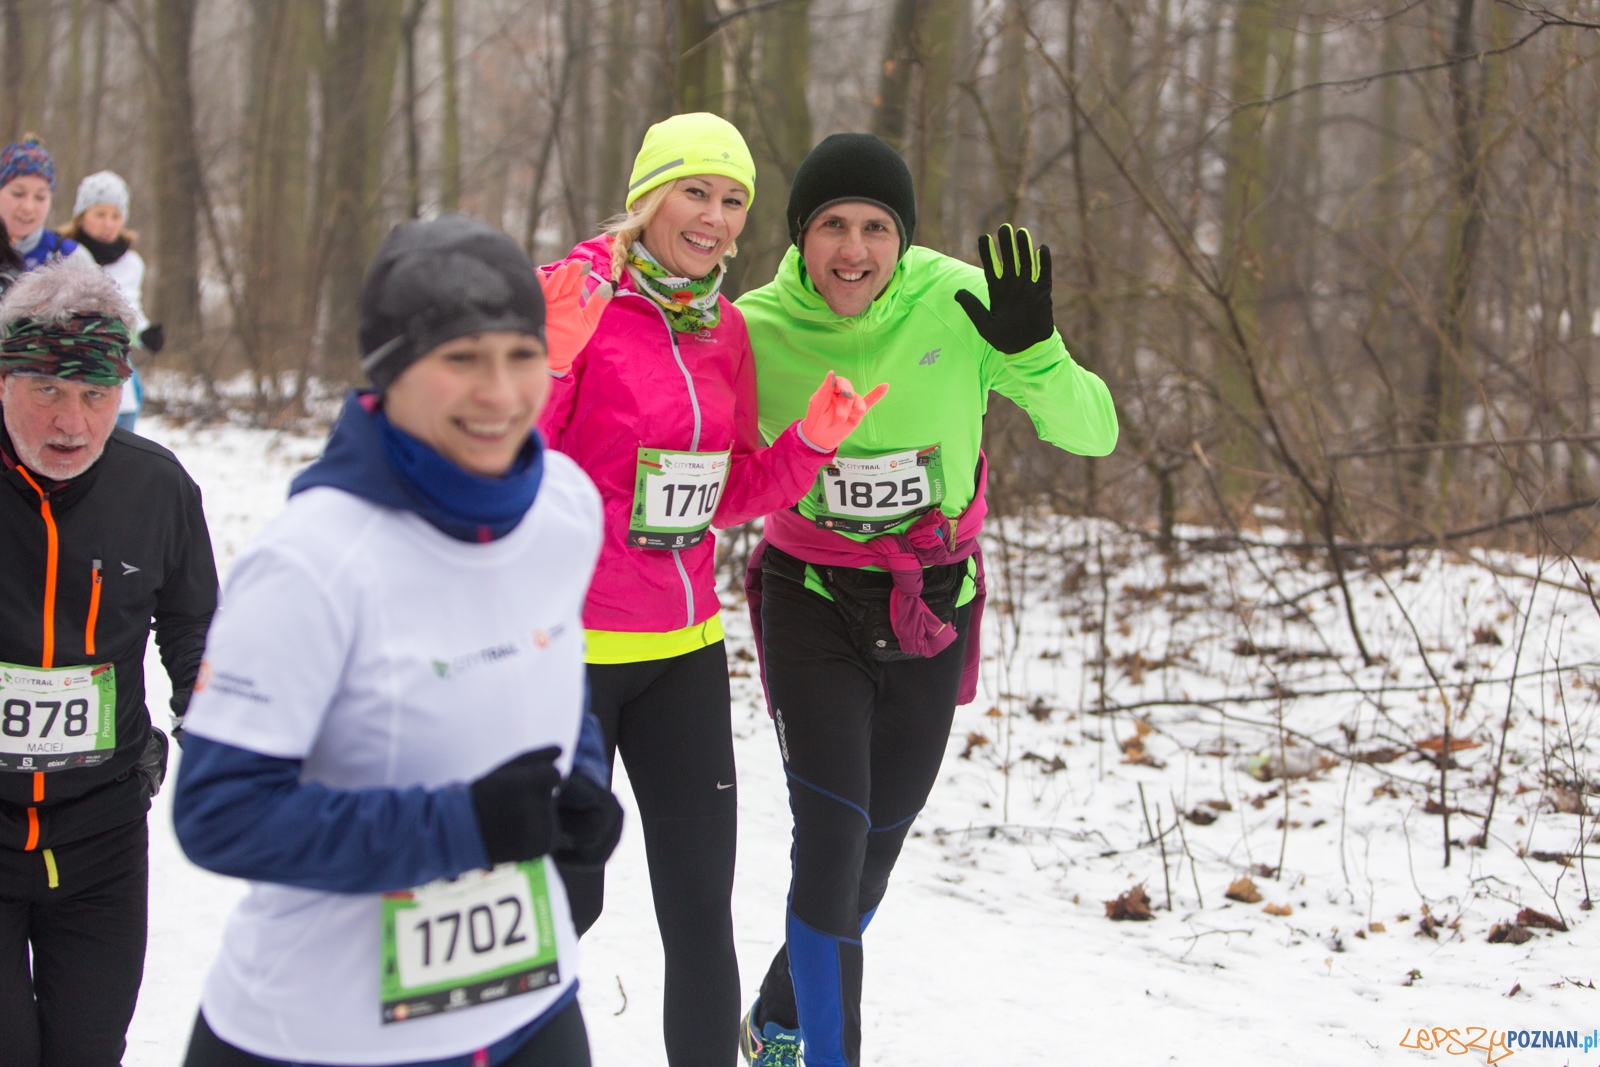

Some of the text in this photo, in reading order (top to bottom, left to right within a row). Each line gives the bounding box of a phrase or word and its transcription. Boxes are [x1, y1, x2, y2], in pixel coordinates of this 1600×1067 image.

[662, 481, 720, 517] 1710
[834, 476, 923, 508] 1825
[2, 698, 89, 738] 878
[102, 703, 111, 738] Poznań
[26, 742, 64, 753] MACIEJ
[414, 896, 527, 966] 1702
